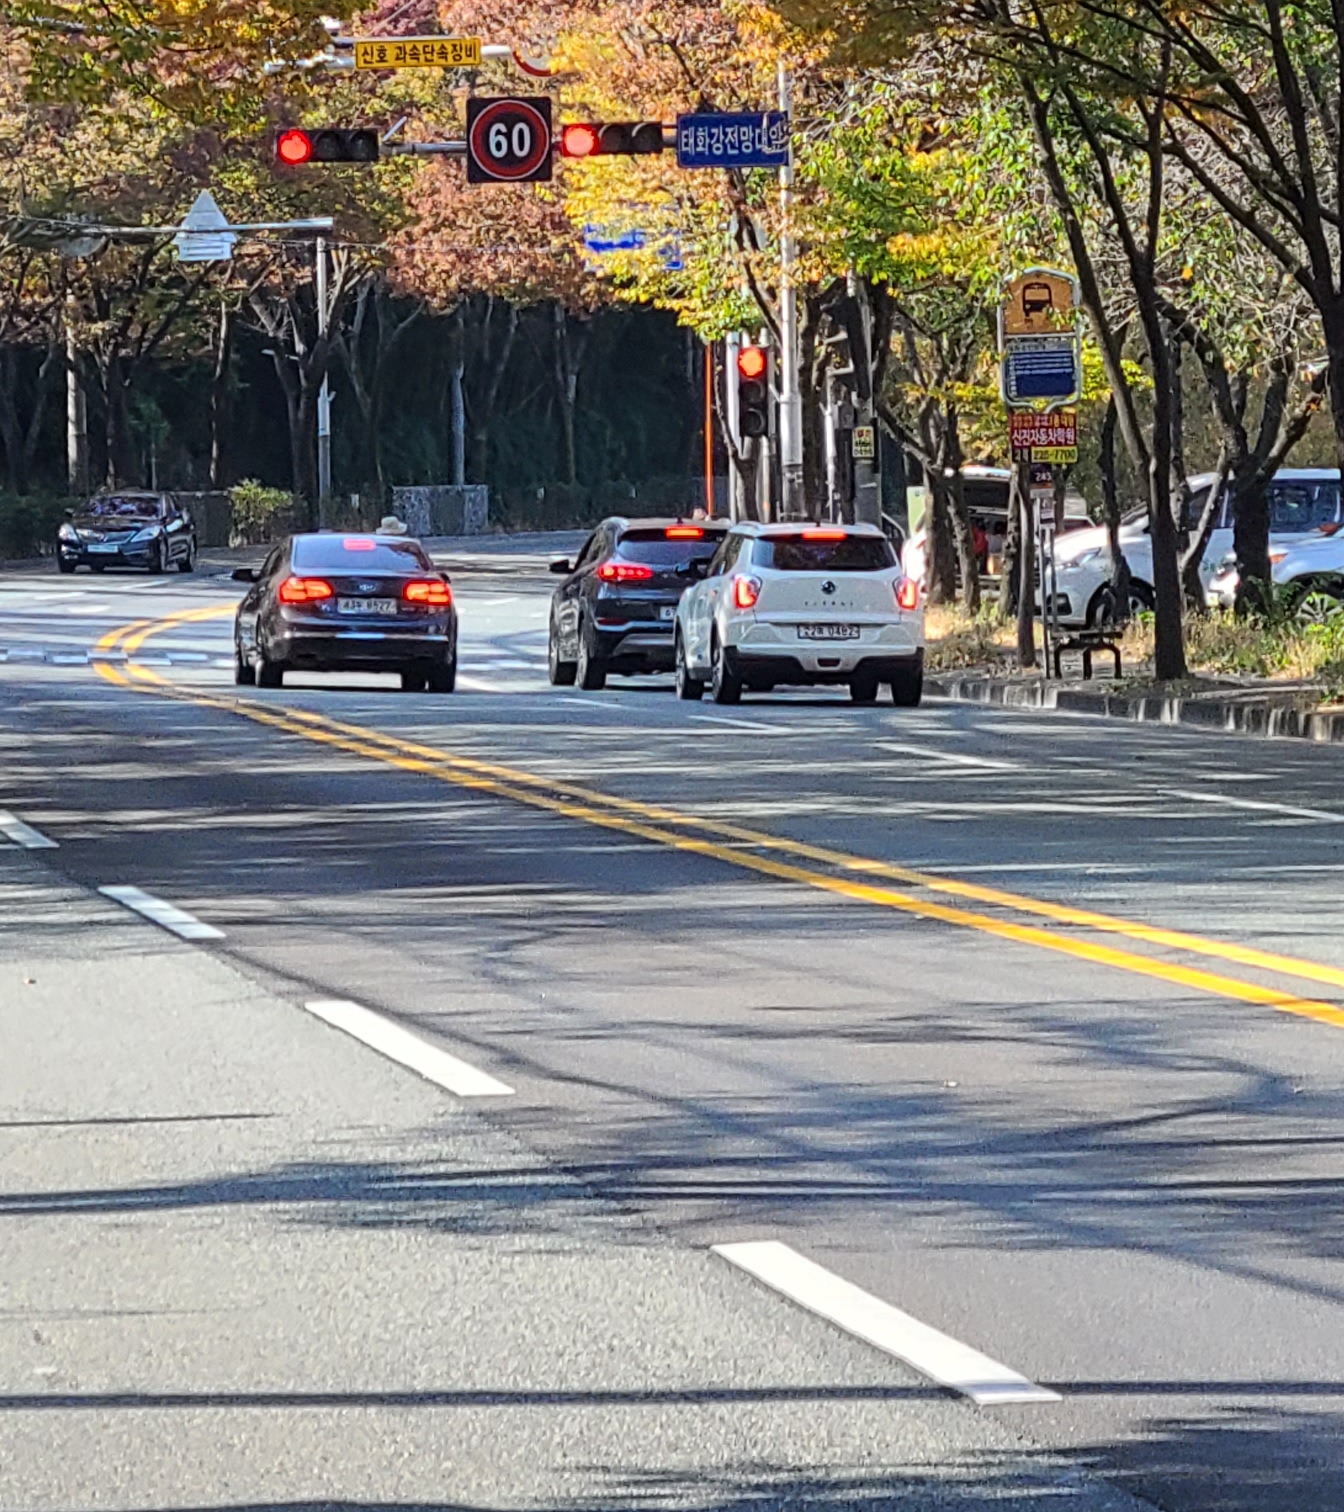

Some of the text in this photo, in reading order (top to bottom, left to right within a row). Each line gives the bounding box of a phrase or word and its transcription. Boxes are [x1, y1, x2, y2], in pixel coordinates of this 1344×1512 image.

[362, 41, 477, 65] 신호 과속단속장비
[489, 122, 531, 158] 60
